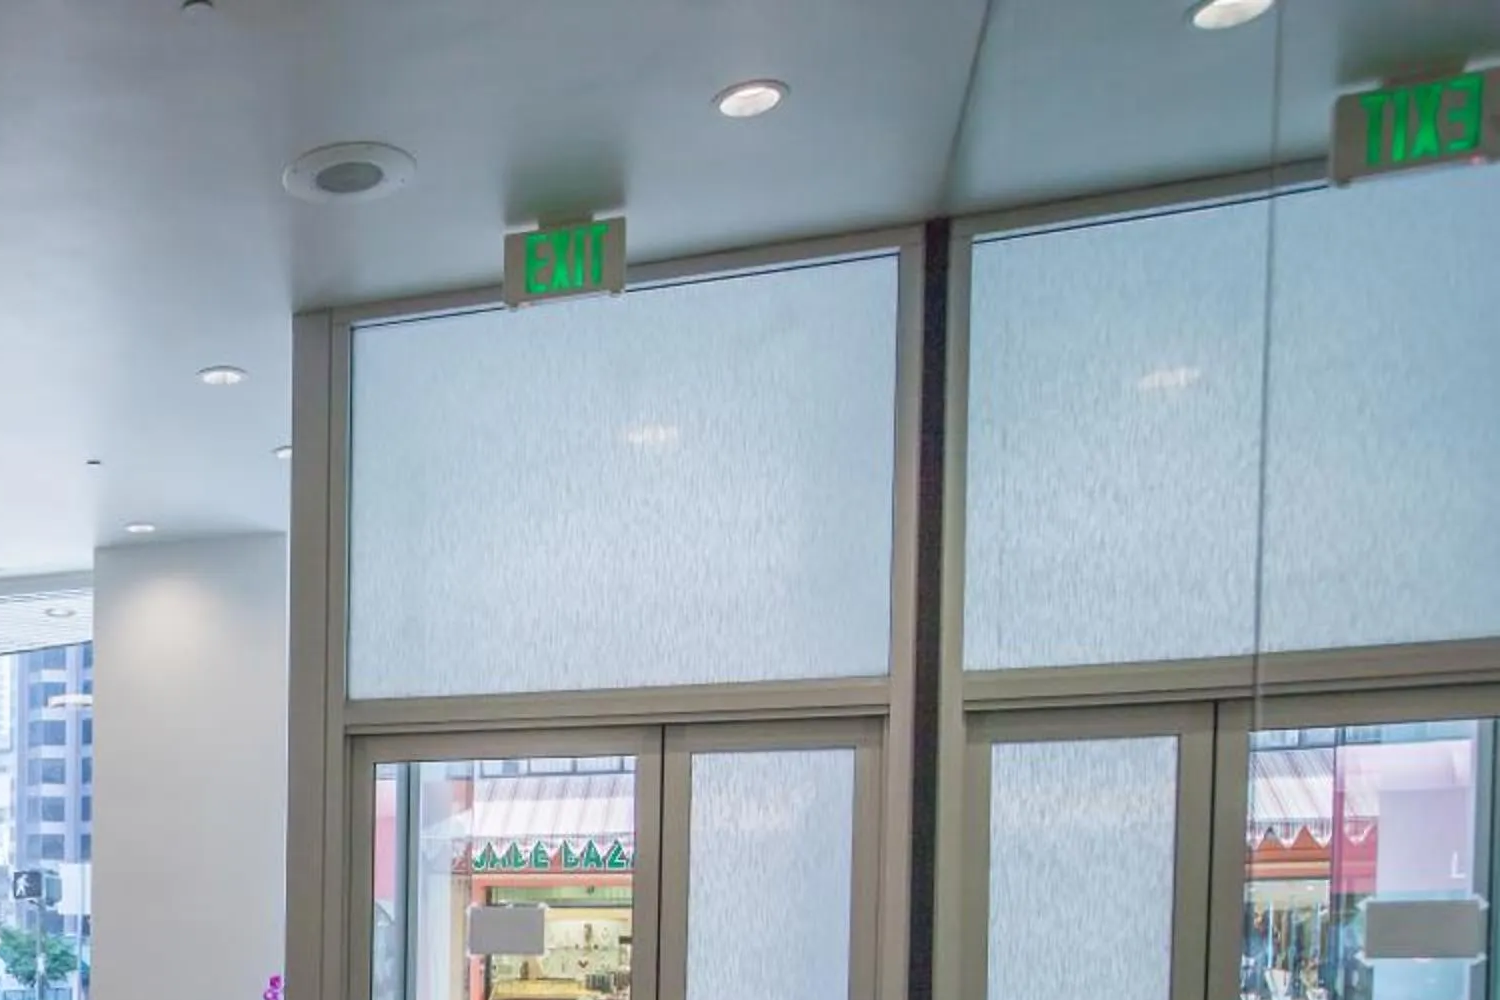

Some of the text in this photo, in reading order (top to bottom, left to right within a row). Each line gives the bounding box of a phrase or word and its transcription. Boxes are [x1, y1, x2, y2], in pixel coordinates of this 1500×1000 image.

[525, 223, 608, 294] EXIT
[473, 841, 634, 869] JADE BAZ
